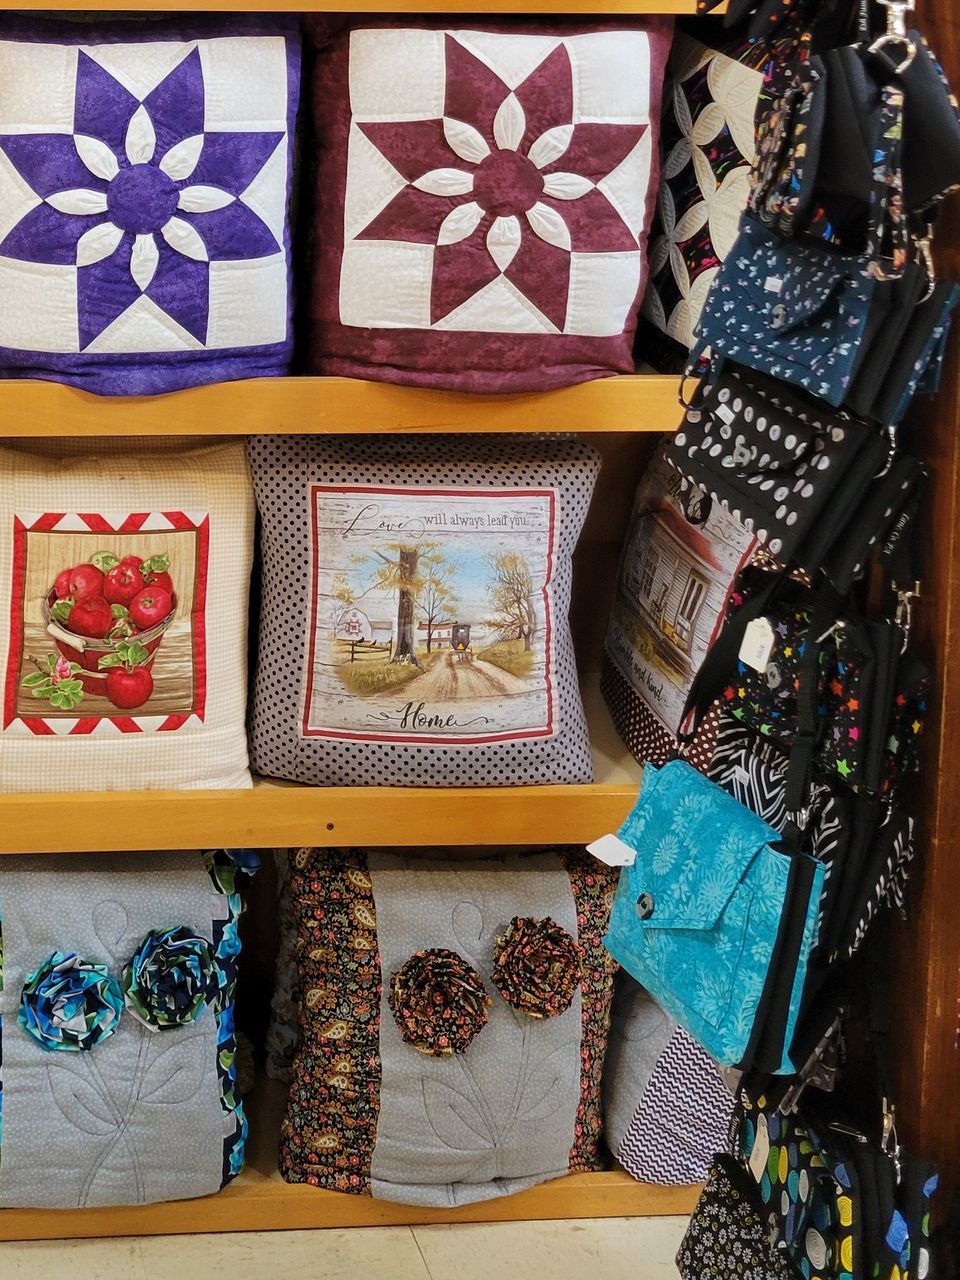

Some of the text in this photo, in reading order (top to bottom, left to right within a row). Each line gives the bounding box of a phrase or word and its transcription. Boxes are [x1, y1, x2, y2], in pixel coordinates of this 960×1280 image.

[341, 504, 425, 539] Love
[424, 513, 448, 525] will
[450, 514, 485, 530] always
[487, 514, 507, 526] lead
[395, 701, 464, 730] Home
